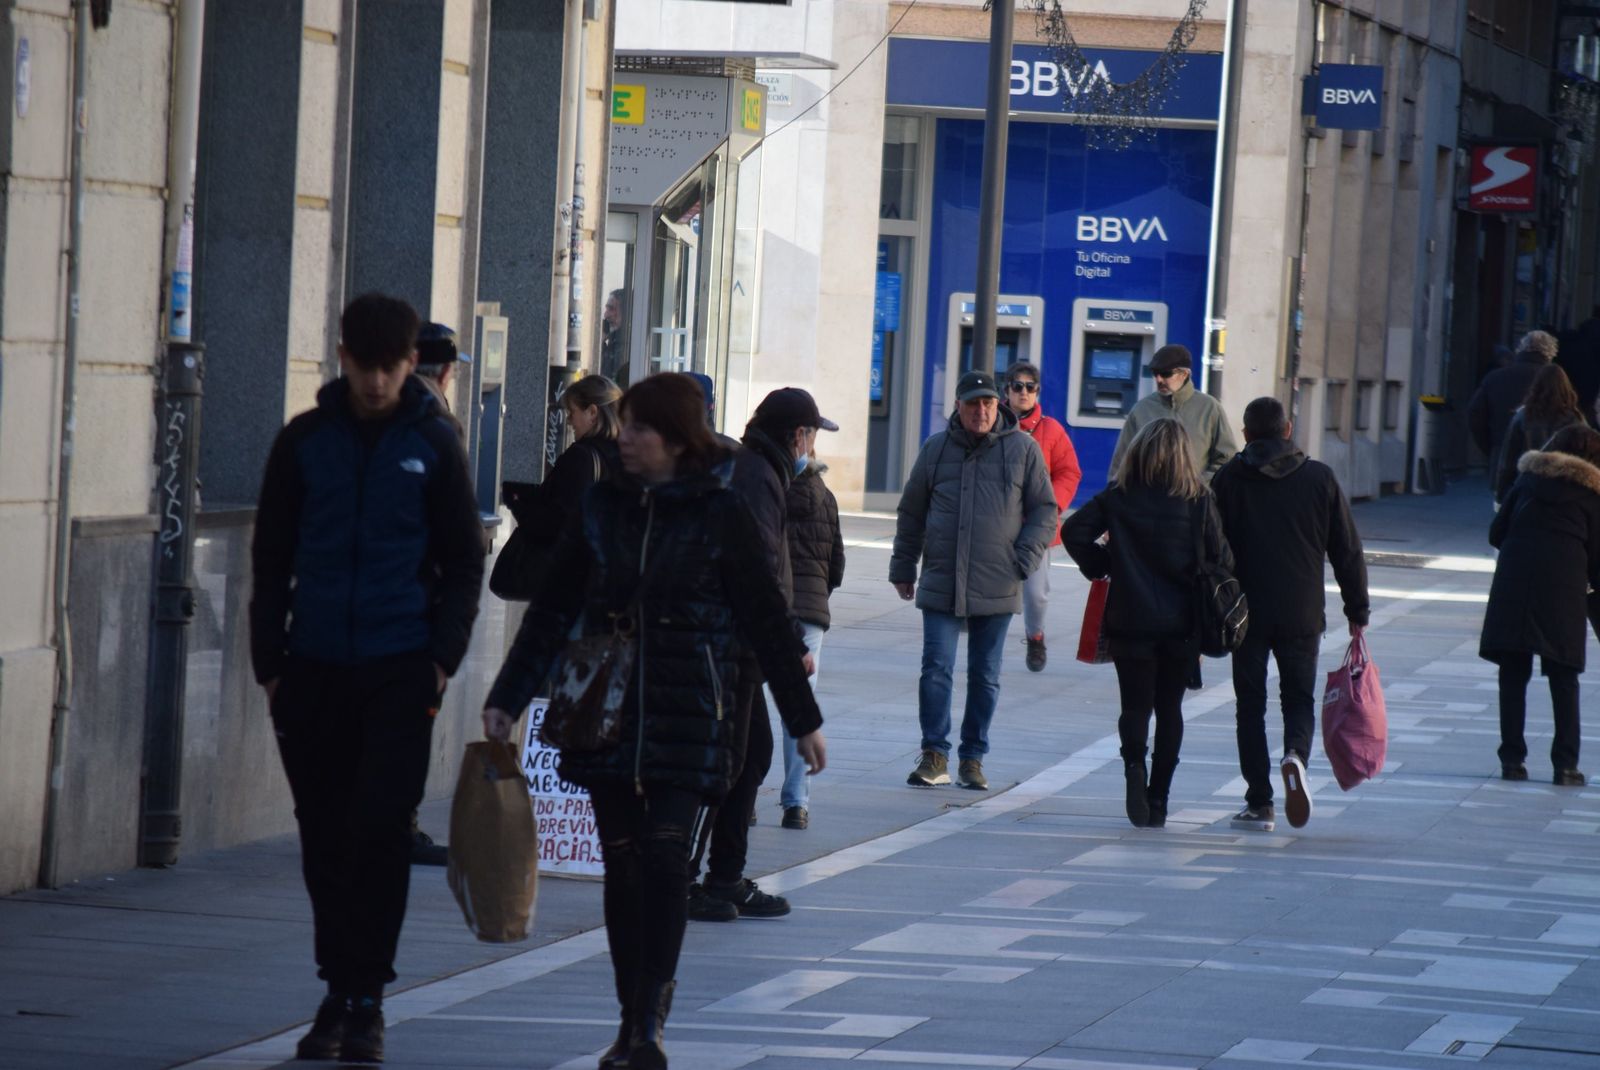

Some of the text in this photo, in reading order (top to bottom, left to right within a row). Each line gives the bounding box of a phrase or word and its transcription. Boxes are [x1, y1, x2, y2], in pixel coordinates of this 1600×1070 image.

[1009, 60, 1114, 97] BBVA
[767, 93, 789, 101] UCIÓN
[1322, 88, 1376, 104] BBVA
[1076, 215, 1168, 243] BBVA
[1075, 250, 1131, 264] Tu Oficina
[1075, 265, 1111, 279] Digital
[1103, 309, 1137, 321] BBVA
[524, 750, 562, 770] NEC
[532, 797, 593, 817] DO PAR
